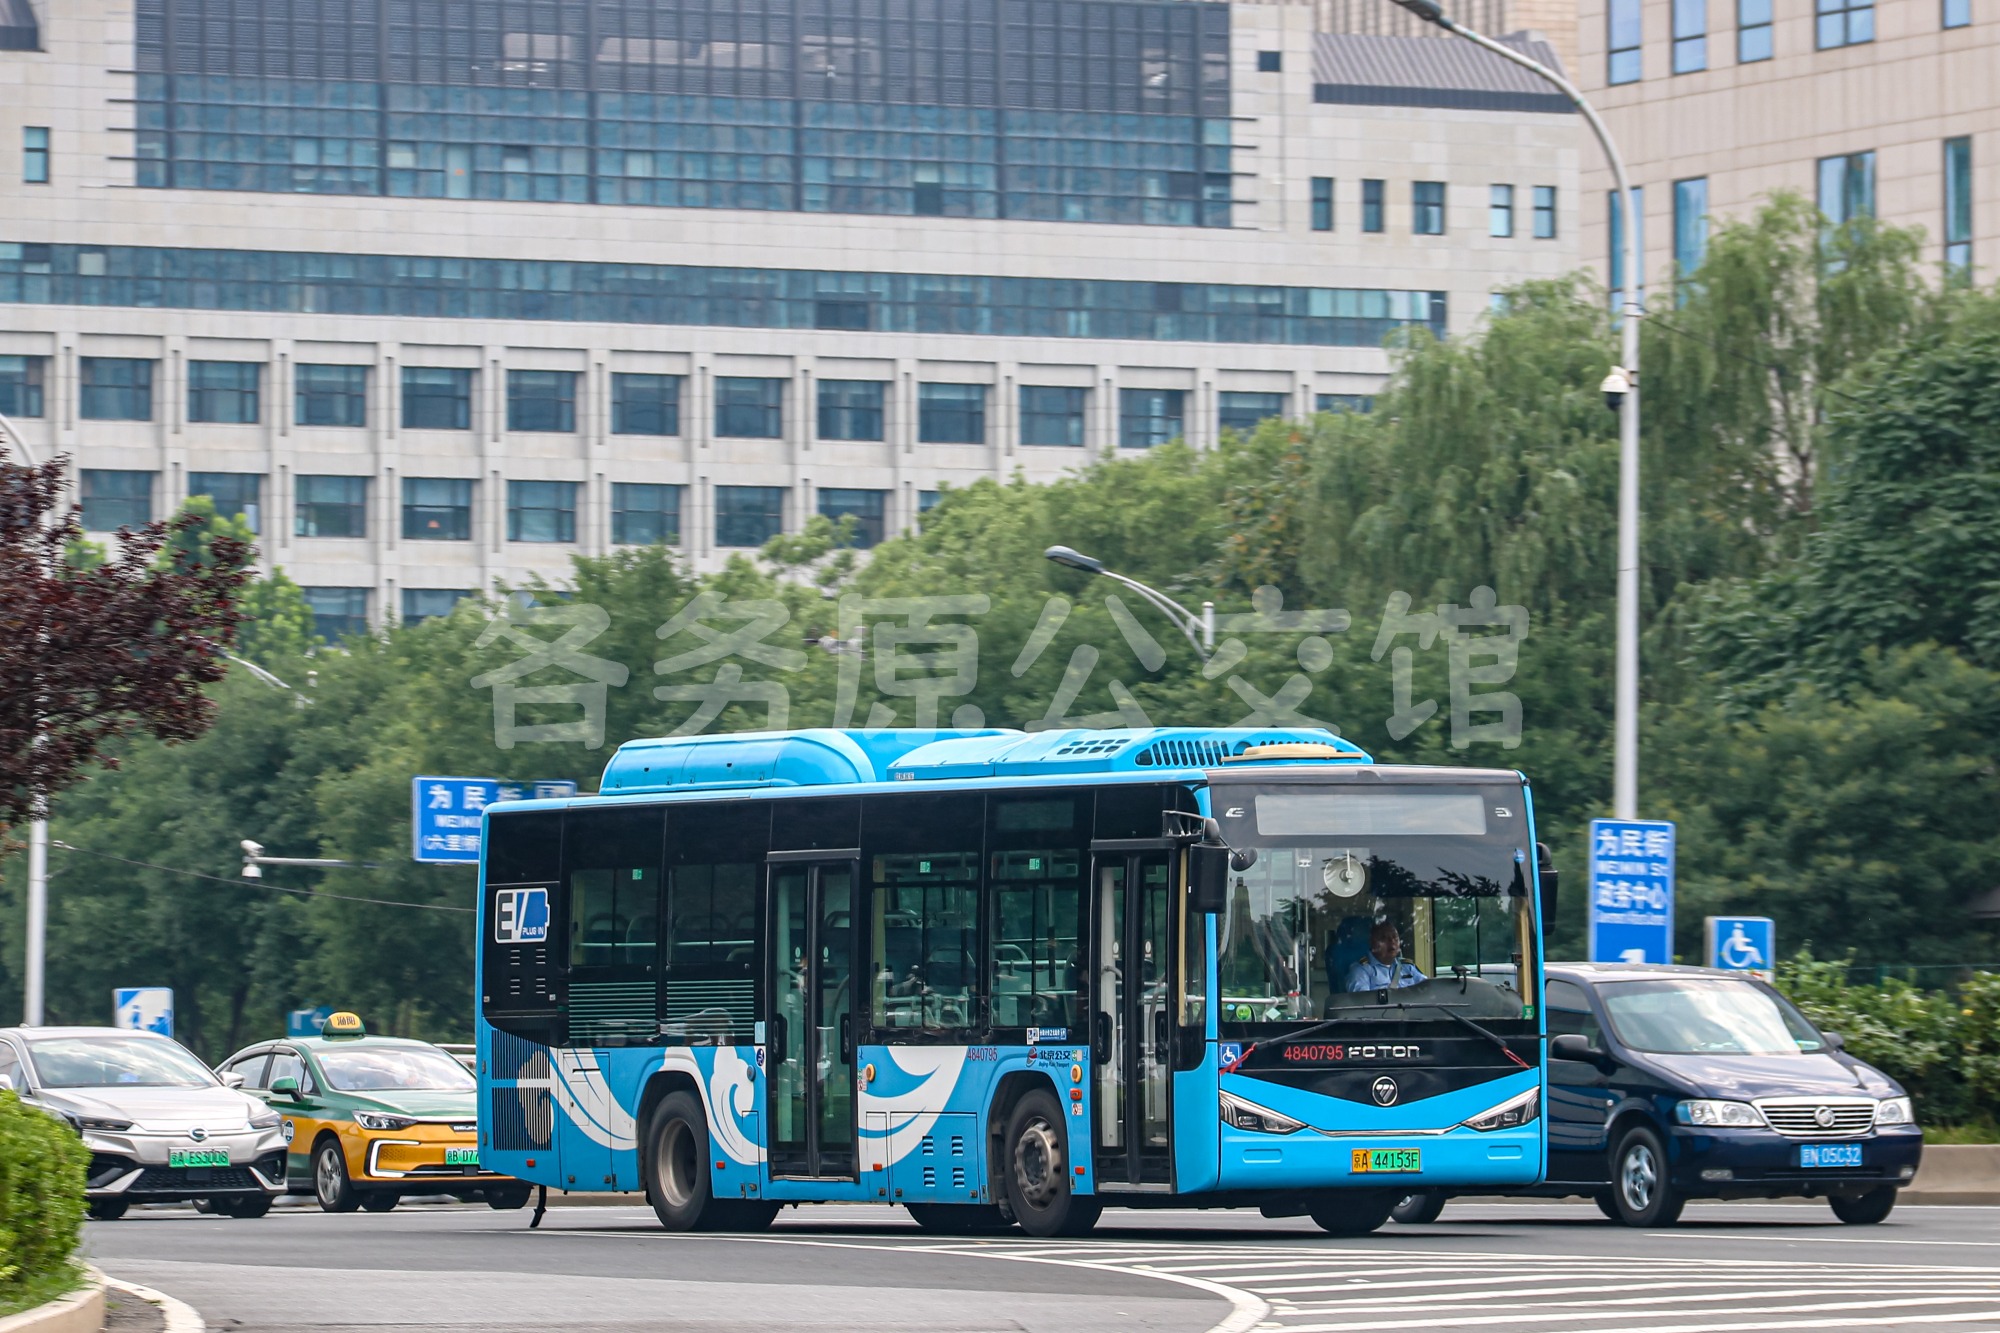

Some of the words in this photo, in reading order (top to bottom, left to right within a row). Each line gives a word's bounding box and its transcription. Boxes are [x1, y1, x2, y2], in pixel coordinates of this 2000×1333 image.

[1596, 880, 1668, 909] 政务中心
[522, 927, 537, 936] PLUG
[537, 926, 545, 935] IN
[967, 1047, 998, 1061] 4840795
[1039, 1049, 1071, 1060] 北京公交
[1283, 1045, 1344, 1060] 4840795
[1348, 1045, 1420, 1058] FOTON
